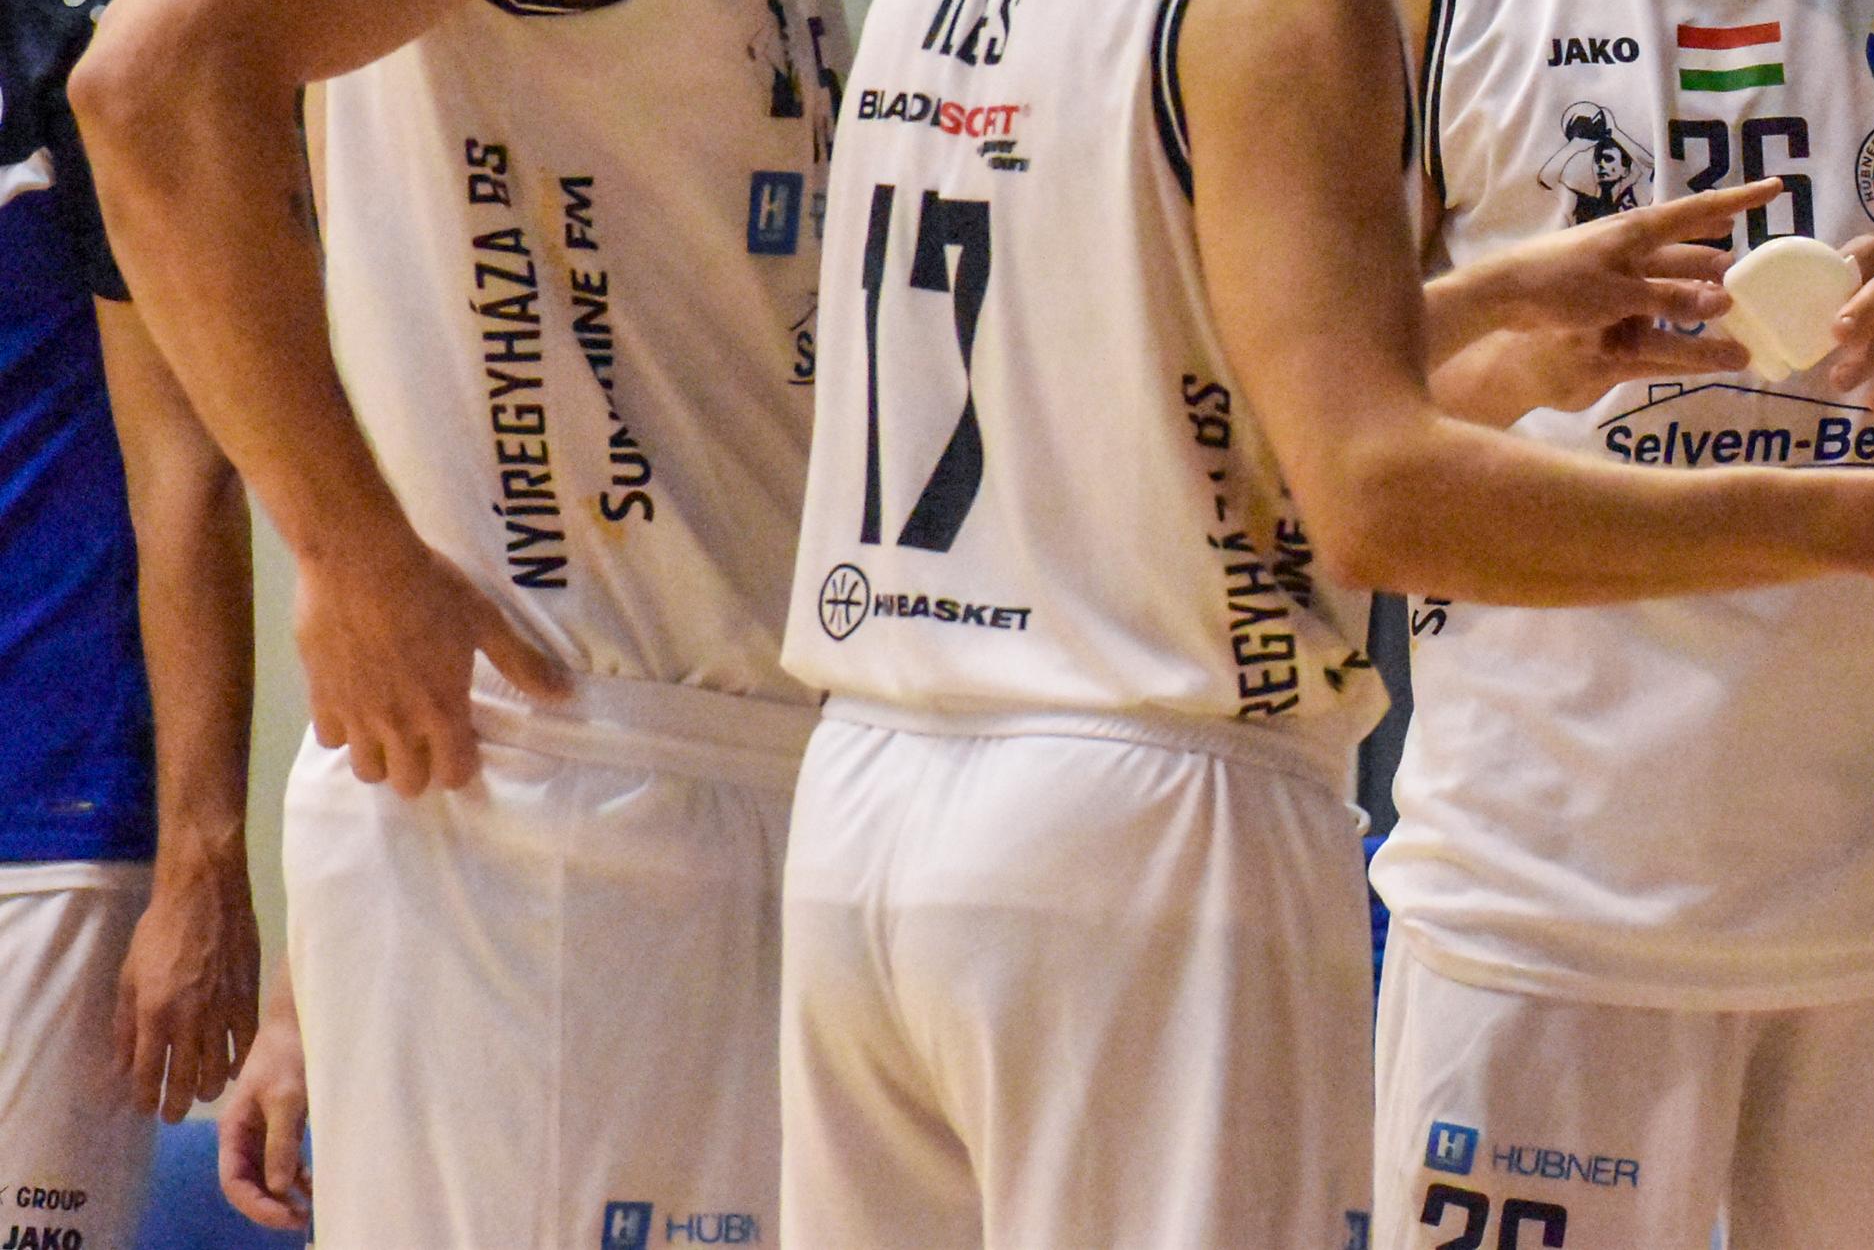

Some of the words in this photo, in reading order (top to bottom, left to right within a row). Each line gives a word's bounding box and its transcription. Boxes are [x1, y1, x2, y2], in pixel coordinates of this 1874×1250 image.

[1548, 37, 1640, 67] JAKO
[559, 176, 599, 250] FM
[469, 227, 568, 588] NYÍREGYHÁZA
[1492, 1143, 1640, 1188] HÜBNER
[16, 1186, 87, 1211] GROUP
[3, 1225, 83, 1250] JAKO
